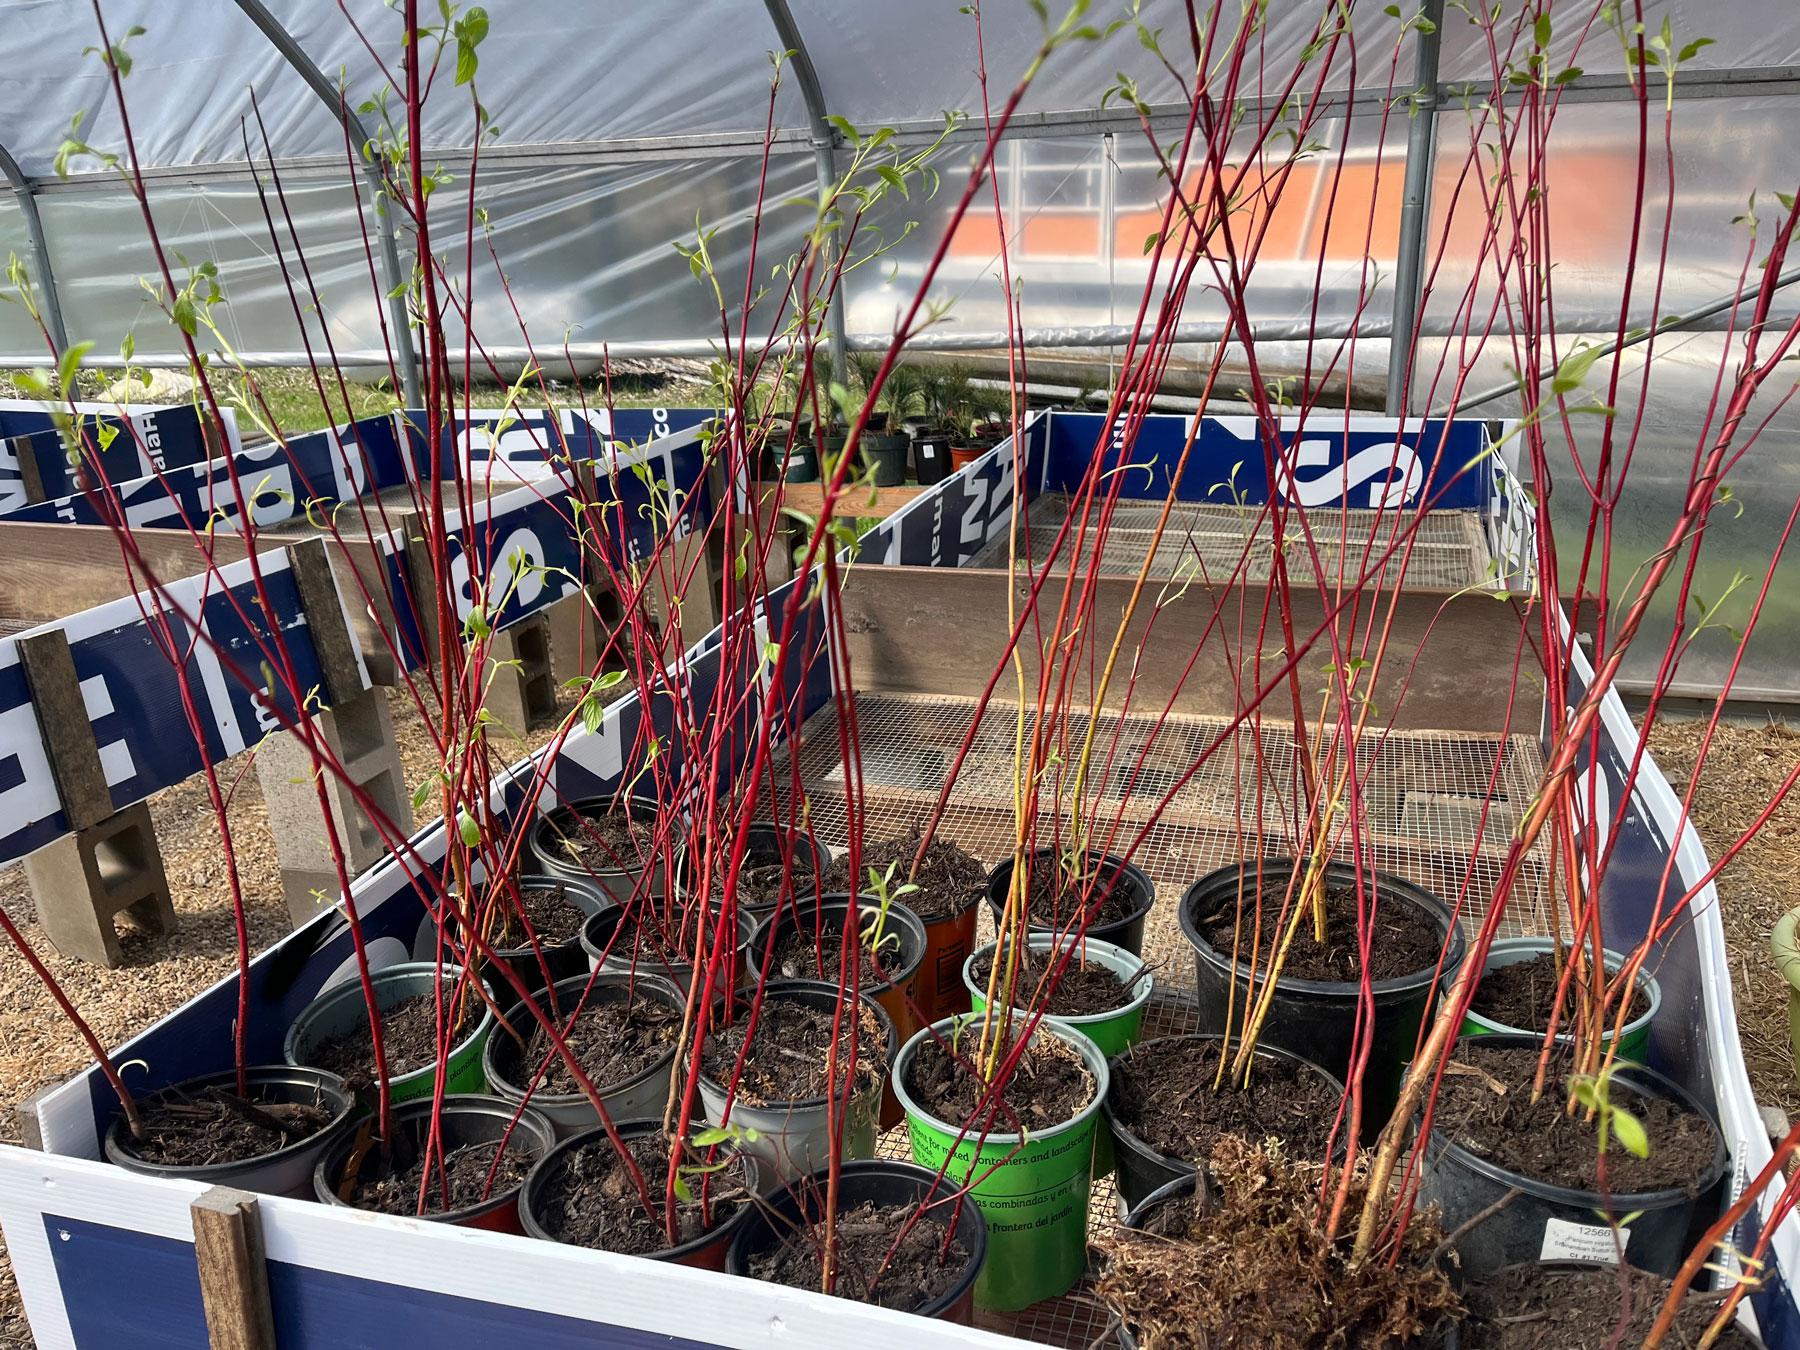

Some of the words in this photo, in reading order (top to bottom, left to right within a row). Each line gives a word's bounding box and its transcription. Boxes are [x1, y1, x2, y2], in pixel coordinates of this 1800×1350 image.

[942, 1145, 969, 1162] mxed
[975, 1154, 1028, 1166] ontaners
[1030, 1151, 1050, 1163] and
[989, 1193, 1048, 1209] combinadas
[993, 1220, 1033, 1234] frontera
[1036, 1217, 1049, 1228] del
